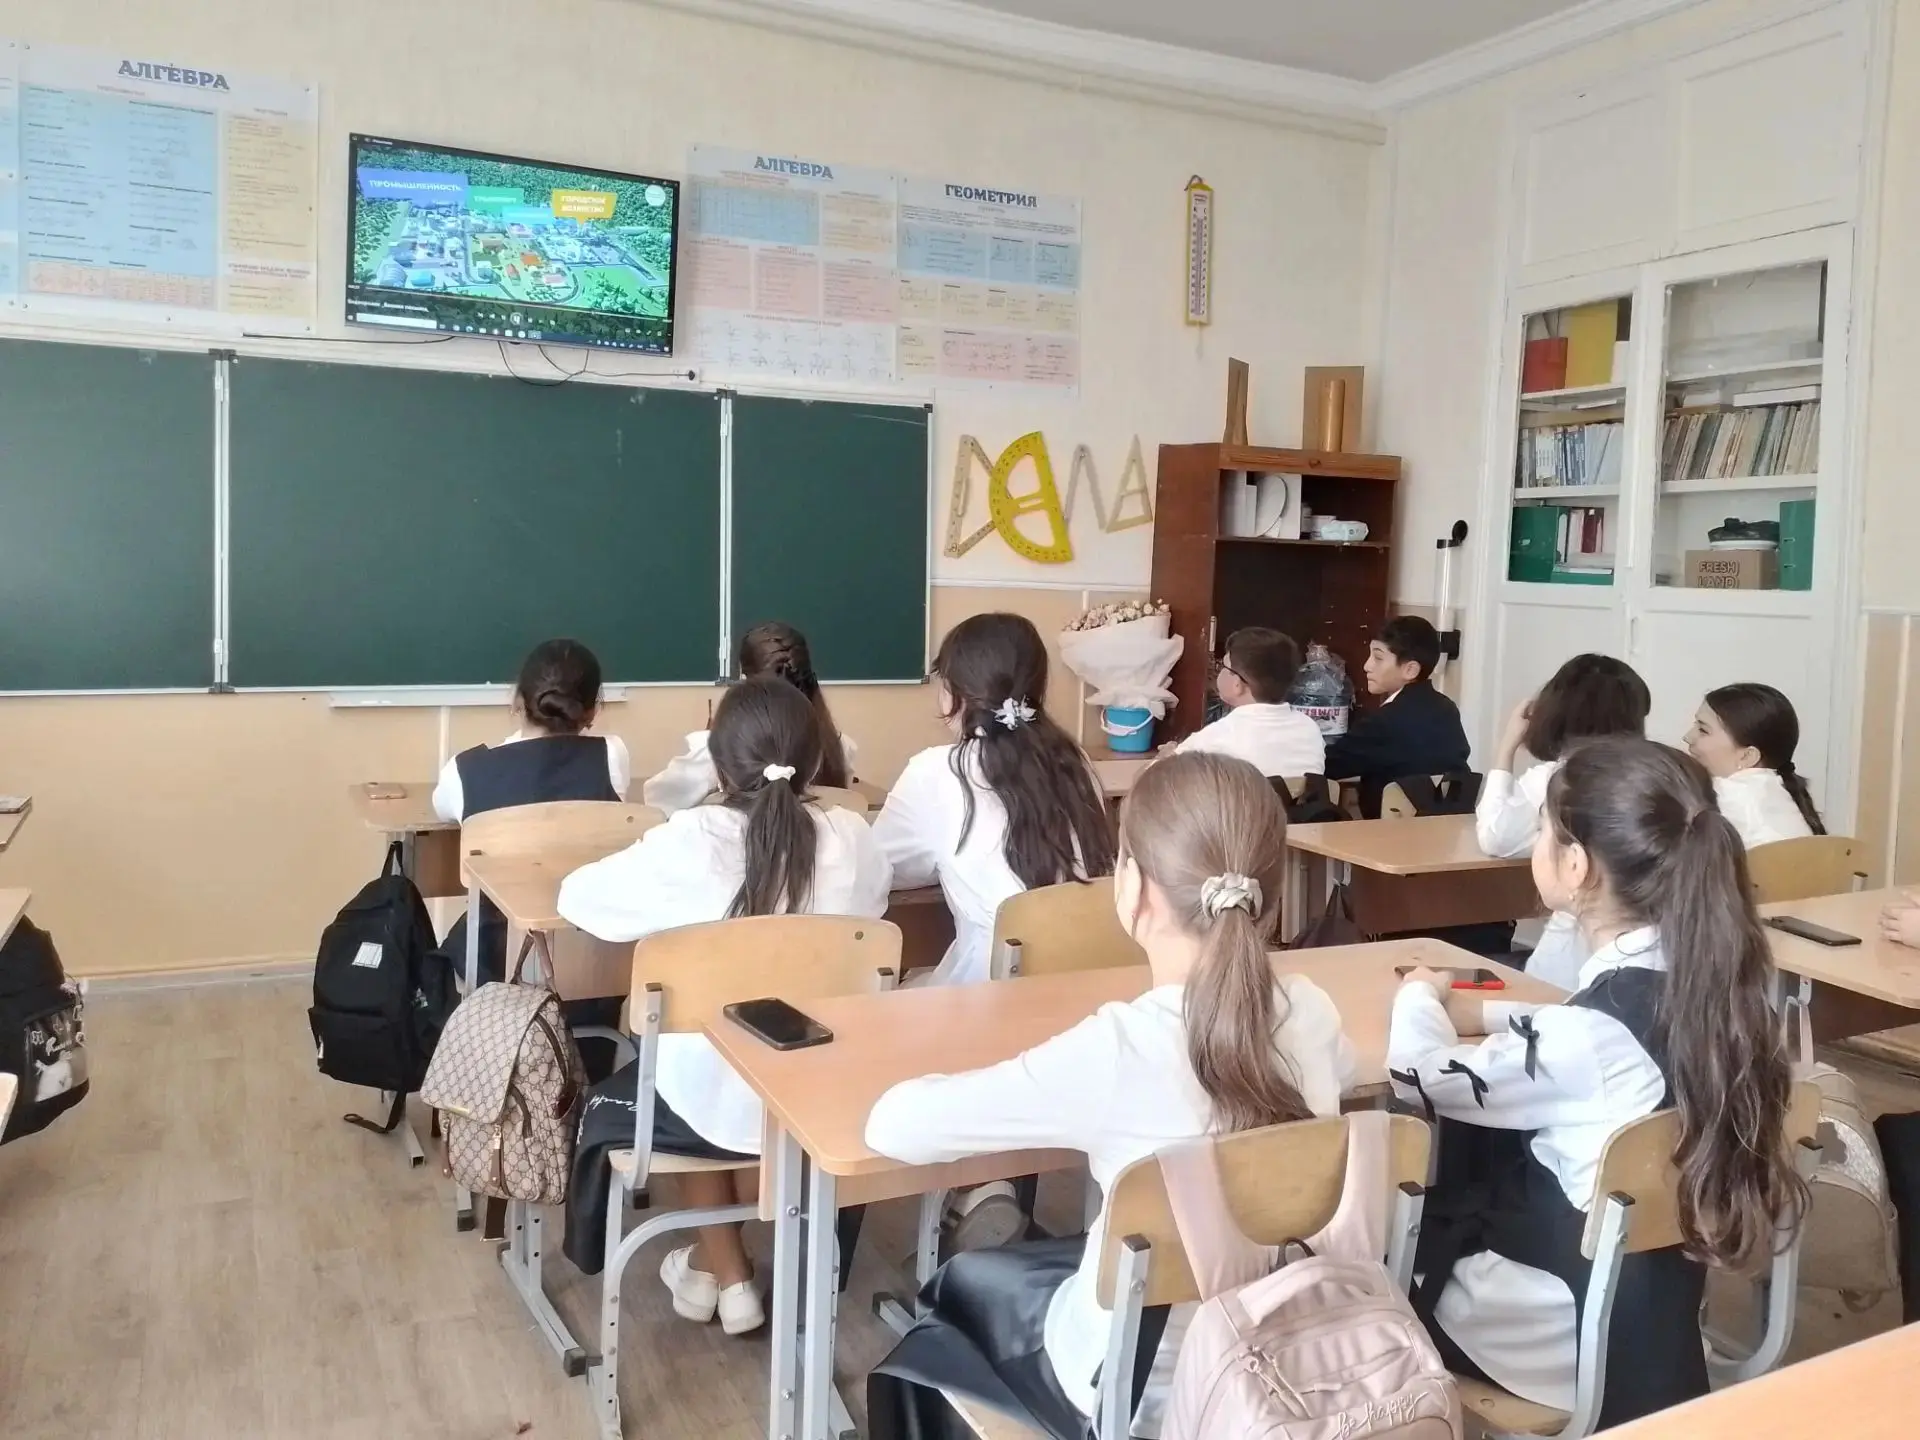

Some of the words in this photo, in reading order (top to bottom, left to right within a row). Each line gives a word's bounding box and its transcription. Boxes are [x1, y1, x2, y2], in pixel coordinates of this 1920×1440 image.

[118, 60, 230, 90] АЛГЕБРА
[754, 156, 834, 179] АЛГЕБРА
[368, 180, 463, 191] ПРОМЫШЛЕННОСТЬ
[945, 184, 1037, 207] ГЕОМЕТРИЯ
[1699, 561, 1737, 574] FRESH
[1698, 575, 1737, 588] LAND
